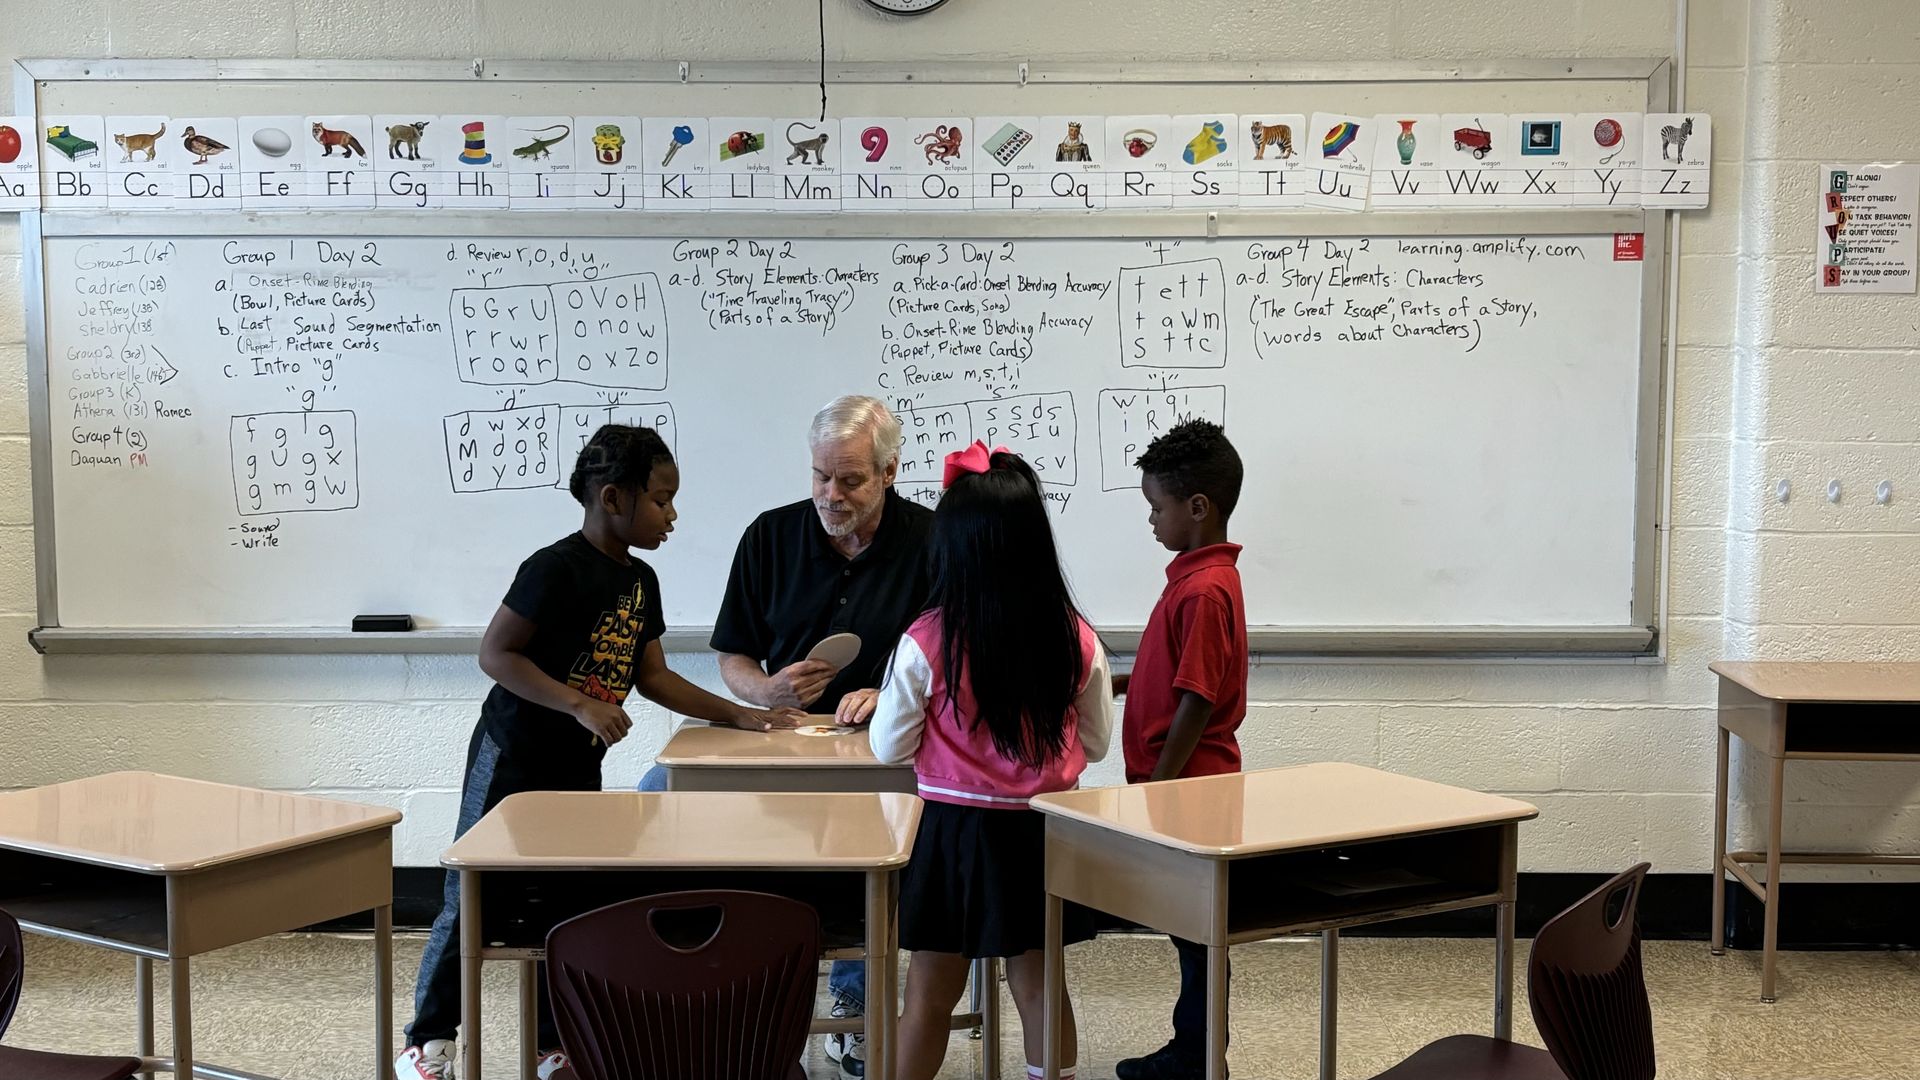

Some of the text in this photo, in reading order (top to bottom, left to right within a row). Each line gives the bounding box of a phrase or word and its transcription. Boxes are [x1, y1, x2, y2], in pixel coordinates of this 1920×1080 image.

[57, 171, 91, 196] Bb
[124, 172, 158, 196] Cc
[189, 174, 223, 197] Dd
[260, 171, 289, 196] Ee
[327, 171, 354, 195] Ff
[389, 171, 427, 207] Gg
[459, 171, 492, 196] Hh
[536, 173, 549, 197] Ii
[594, 173, 625, 208] Jj
[662, 174, 693, 198] Kk
[732, 173, 753, 198] Ll
[785, 175, 831, 199] Mm
[858, 174, 891, 198] Nn
[922, 174, 959, 198] Oo
[992, 173, 1023, 209] Pp
[1051, 172, 1094, 208] Qq
[1125, 171, 1154, 196] Rr
[1191, 171, 1220, 195] Ss
[1259, 171, 1286, 195] Tt
[1319, 170, 1351, 197] Uu
[1391, 170, 1419, 194] Vv
[1446, 170, 1499, 194] Ww
[1523, 169, 1556, 193] Xx
[1594, 169, 1621, 205] Yy
[1660, 170, 1691, 193] Zz
[223, 240, 382, 268] Group 1 Day 2
[447, 243, 511, 261] d. Review
[673, 239, 796, 268] Group 2 Day 2
[892, 242, 1015, 276] Group 3 Day 2
[1247, 237, 1585, 272] Group 4 Day 2 learning.amplify.com
[716, 267, 753, 297] Story
[825, 263, 879, 285] Characters
[894, 281, 911, 293] a.
[1017, 275, 1057, 299] Blending
[1065, 272, 1111, 300] Accuracy
[1282, 269, 1323, 301] Story
[1329, 264, 1396, 288] Elements:
[1406, 268, 1483, 288] Characters
[78, 300, 129, 319] Jeffrey
[233, 291, 375, 313] (Bowl, Picture Cards)
[749, 289, 802, 312] Traveling
[889, 296, 939, 317] (Picture
[945, 300, 979, 316] Cards,
[1294, 297, 1335, 316] Great
[1401, 300, 1440, 316] Parts
[1449, 296, 1470, 317] of
[1480, 306, 1490, 315] a
[1491, 297, 1537, 327] Story,
[218, 313, 441, 338] b. Last Sound Segmentation
[709, 309, 750, 330] (Parts
[756, 307, 773, 325] of
[781, 315, 792, 323] a
[882, 325, 899, 340] b.
[983, 318, 1034, 341] Blending
[1039, 312, 1093, 336] Accuracy
[287, 336, 379, 352] Picture Cards
[1338, 325, 1384, 342] about
[1393, 319, 1481, 352] Characters)
[939, 340, 981, 355] Picture
[989, 337, 1033, 363] Cards)
[251, 358, 300, 376] Intro
[904, 365, 953, 386] Review
[72, 426, 111, 449] Group
[113, 425, 122, 444] 4
[71, 450, 148, 468] Daquan PM
[242, 534, 278, 548] Write
[591, 611, 644, 641] FAST
